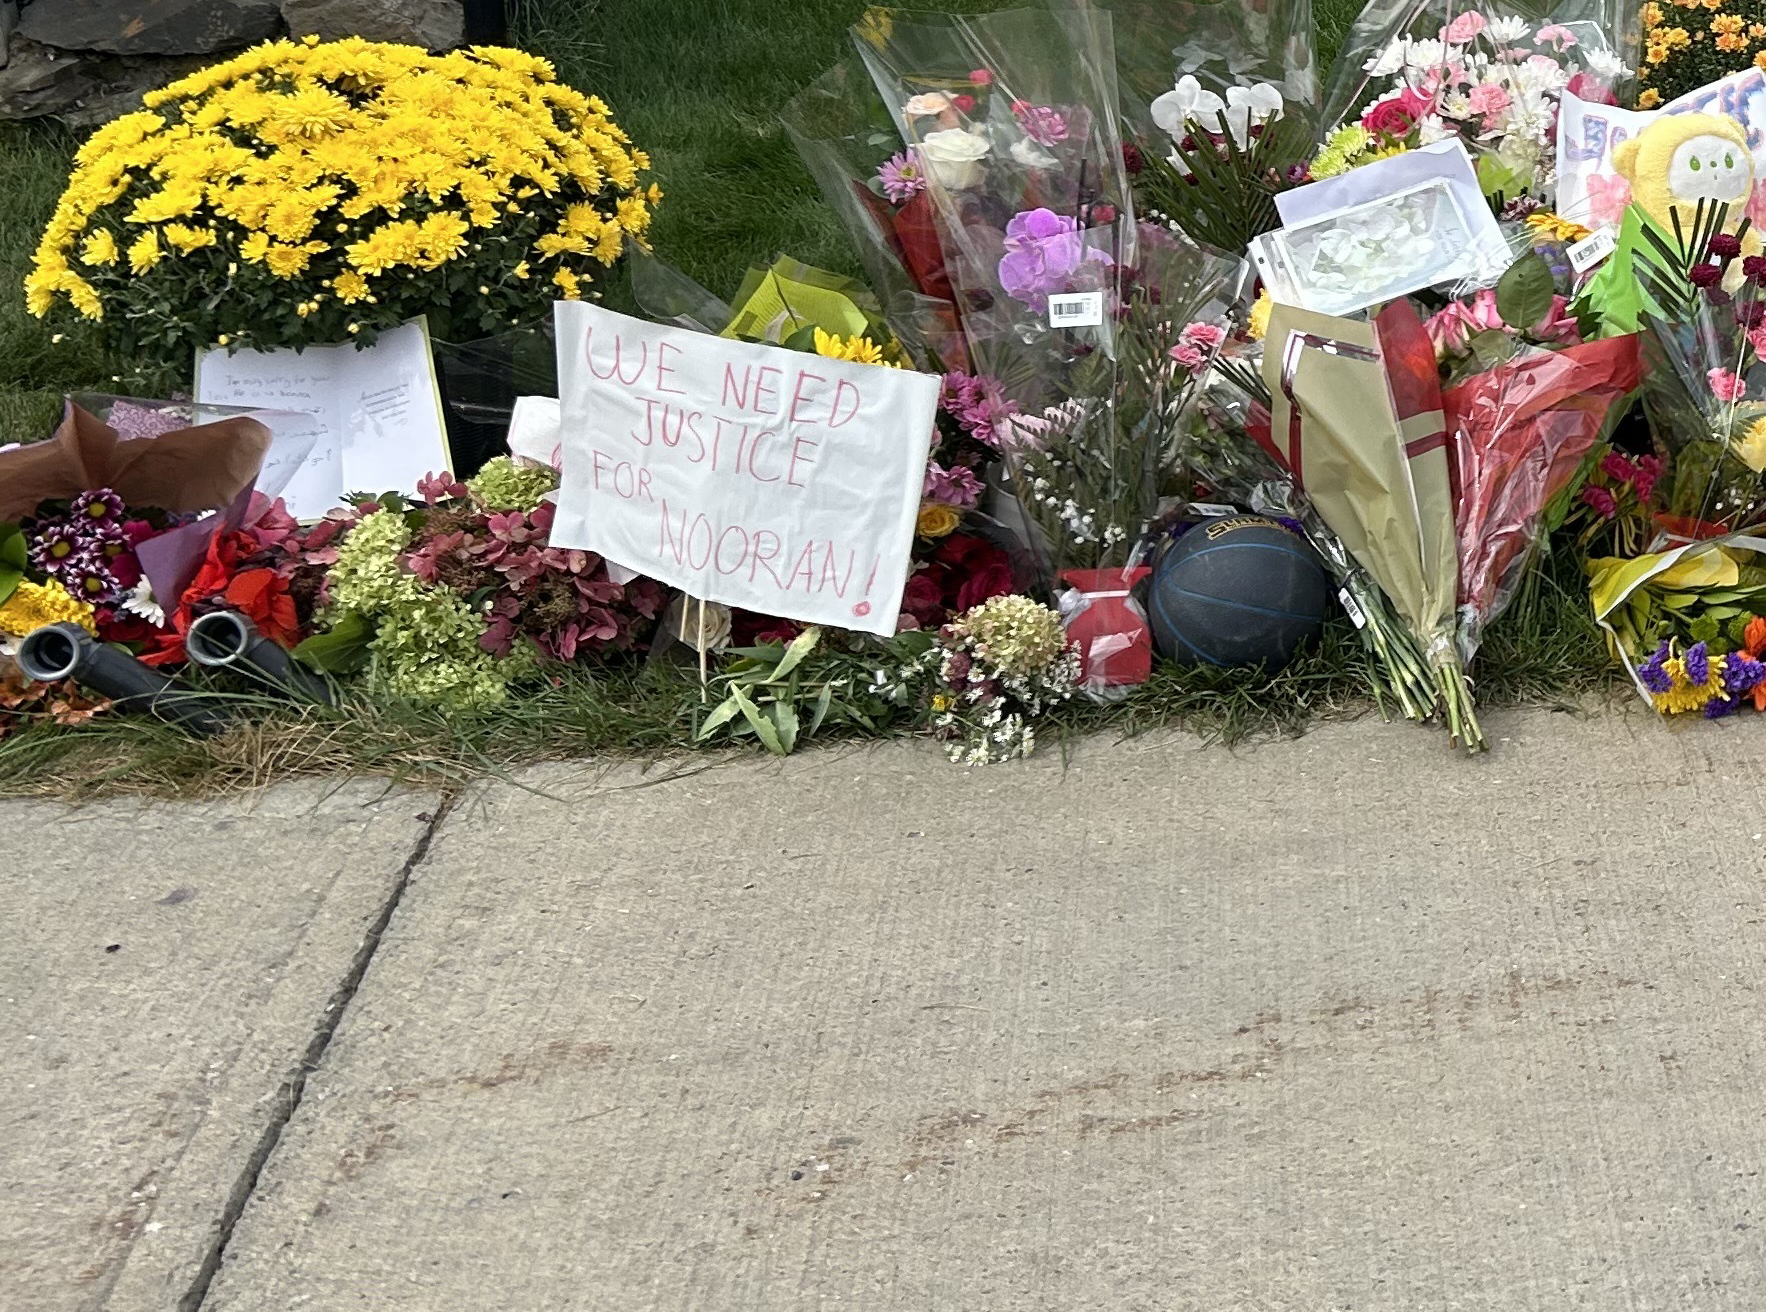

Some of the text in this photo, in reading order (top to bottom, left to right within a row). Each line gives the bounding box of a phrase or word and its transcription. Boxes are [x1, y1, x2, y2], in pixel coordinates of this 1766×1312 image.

[585, 326, 860, 429] WE NEED
[592, 449, 656, 503] FOR
[631, 396, 819, 489] JUSTICE
[658, 497, 881, 618] NOORAN!
